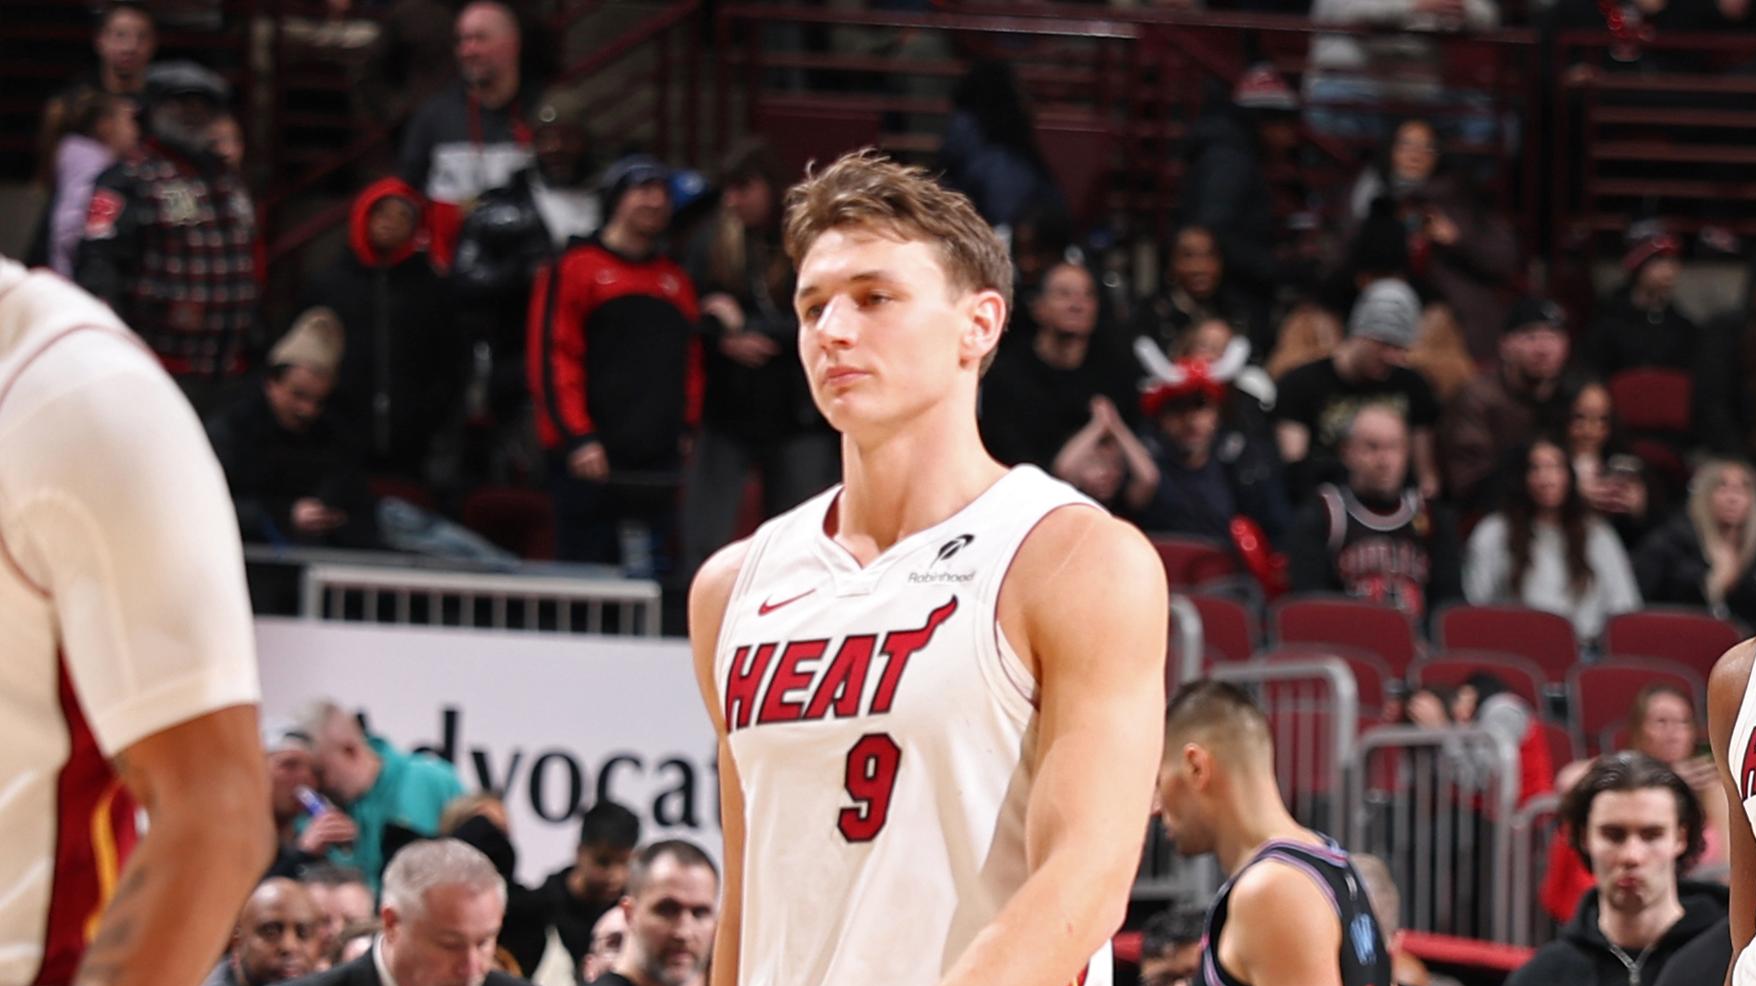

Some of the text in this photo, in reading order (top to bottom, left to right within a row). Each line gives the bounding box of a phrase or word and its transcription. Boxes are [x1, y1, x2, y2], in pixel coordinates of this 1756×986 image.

[907, 568, 976, 584] Robinhood
[725, 594, 958, 735] HEAT
[837, 732, 902, 844] 9
